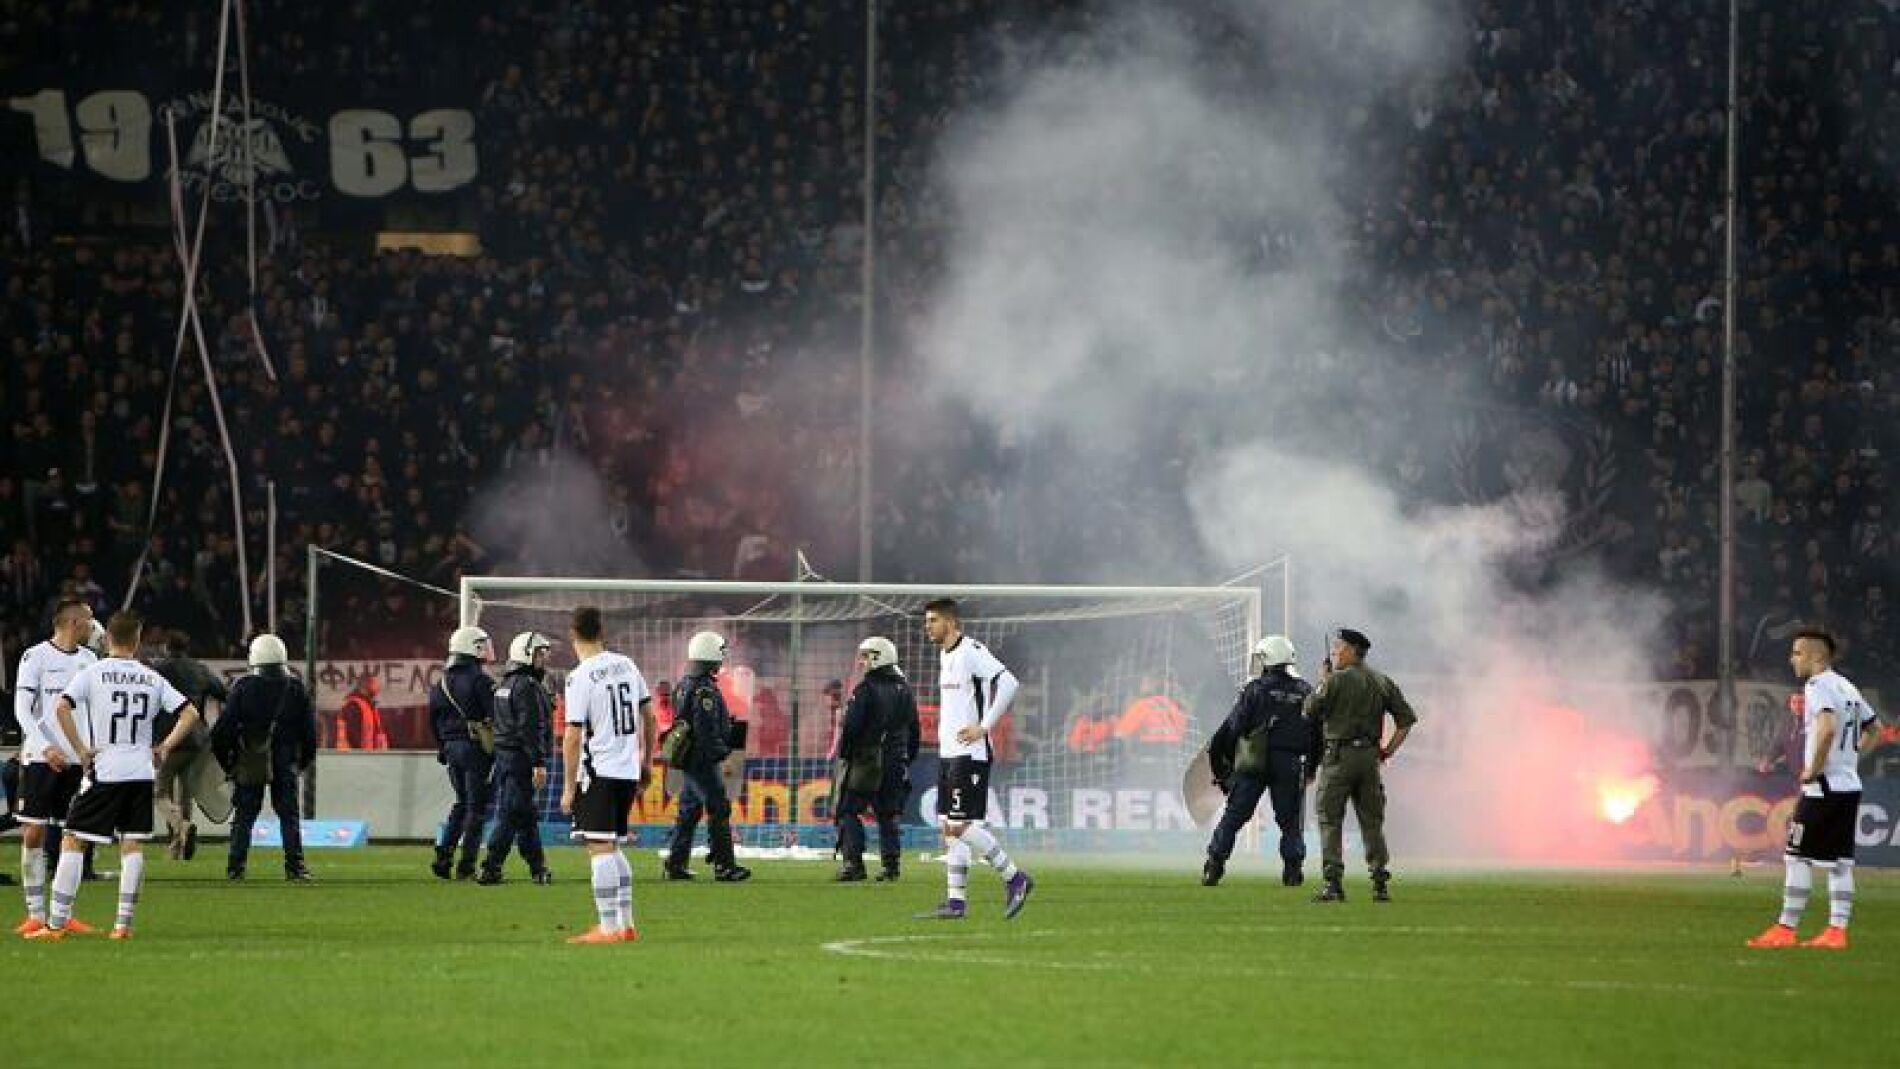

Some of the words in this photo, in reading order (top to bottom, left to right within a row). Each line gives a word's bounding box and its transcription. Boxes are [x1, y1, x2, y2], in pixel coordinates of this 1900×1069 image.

[8, 89, 152, 182] 19
[328, 109, 478, 197] 63
[109, 690, 150, 745] 22
[605, 681, 635, 736] 16
[951, 788, 962, 810] 5
